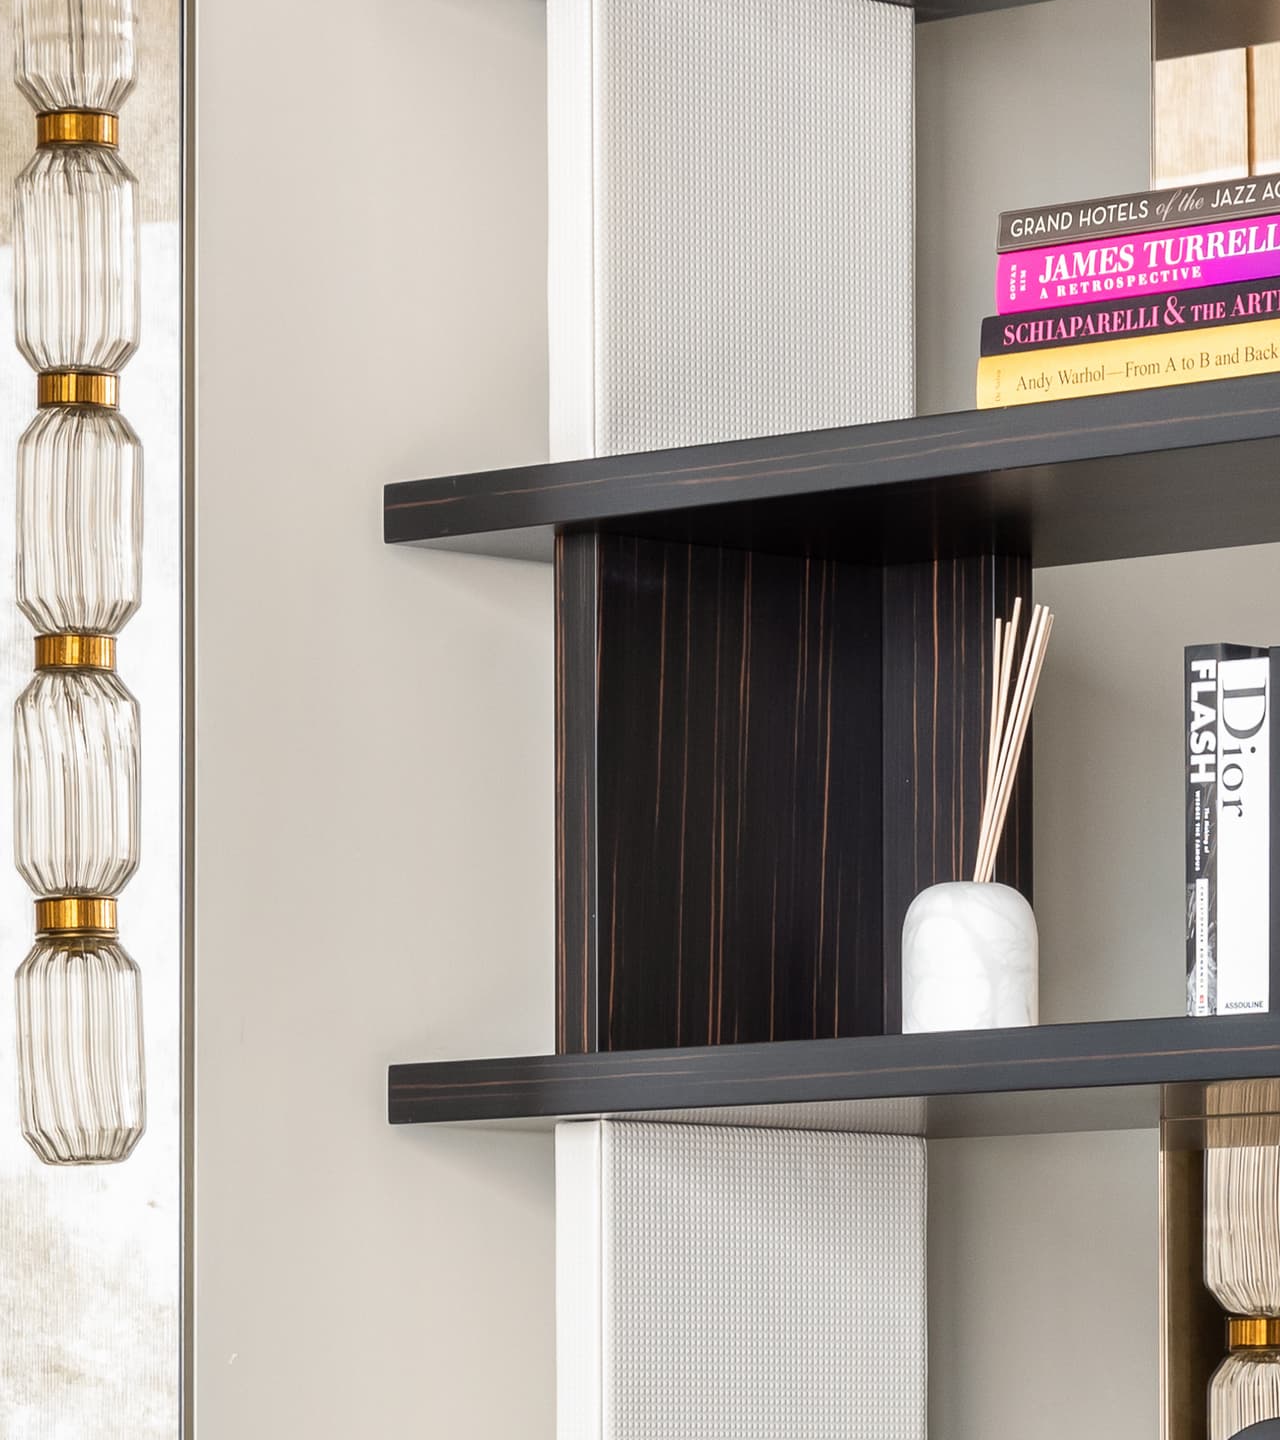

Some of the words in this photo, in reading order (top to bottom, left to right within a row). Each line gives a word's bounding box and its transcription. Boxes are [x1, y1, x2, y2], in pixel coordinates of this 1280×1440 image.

[1010, 212, 1073, 238] GRAND
[1079, 199, 1149, 227] HOTELS
[1155, 188, 1178, 222] of
[1178, 187, 1205, 212] the
[1211, 184, 1257, 208] JAZZ
[1038, 243, 1135, 284] JAMES
[1039, 287, 1049, 300] A
[1057, 265, 1202, 297] RETROSPECTIVE
[1002, 305, 1160, 347] SCHIAPARELLI
[1163, 295, 1186, 325] &
[1190, 302, 1226, 323] THE
[1016, 371, 1054, 392] Andy
[1164, 357, 1177, 373] A
[1182, 355, 1195, 370] to
[1199, 351, 1210, 367] B
[1215, 347, 1240, 366] and
[1244, 343, 1279, 363] Back
[1189, 658, 1217, 783] FLASH
[1221, 677, 1266, 818] Dior
[1224, 1000, 1264, 1009] ASSOULINE
